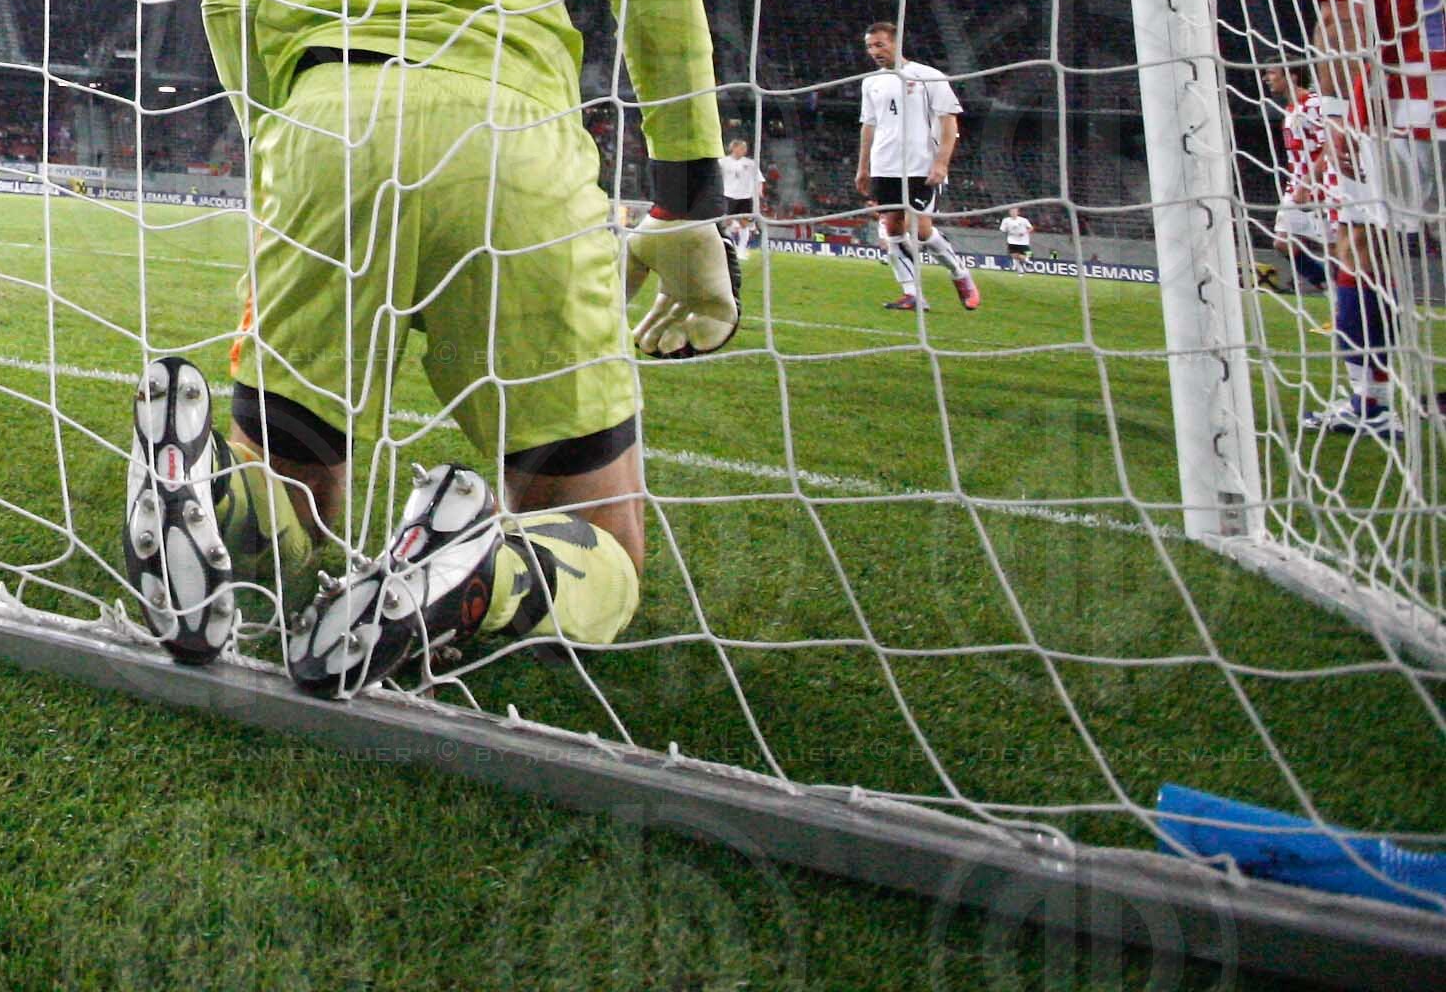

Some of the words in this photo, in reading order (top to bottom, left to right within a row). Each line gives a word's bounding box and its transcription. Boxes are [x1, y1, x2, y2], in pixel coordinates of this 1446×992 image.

[889, 98, 898, 115] 4
[197, 196, 244, 209] JACQUES
[766, 240, 813, 254] EMANS
[1084, 264, 1155, 282] LEMANS
